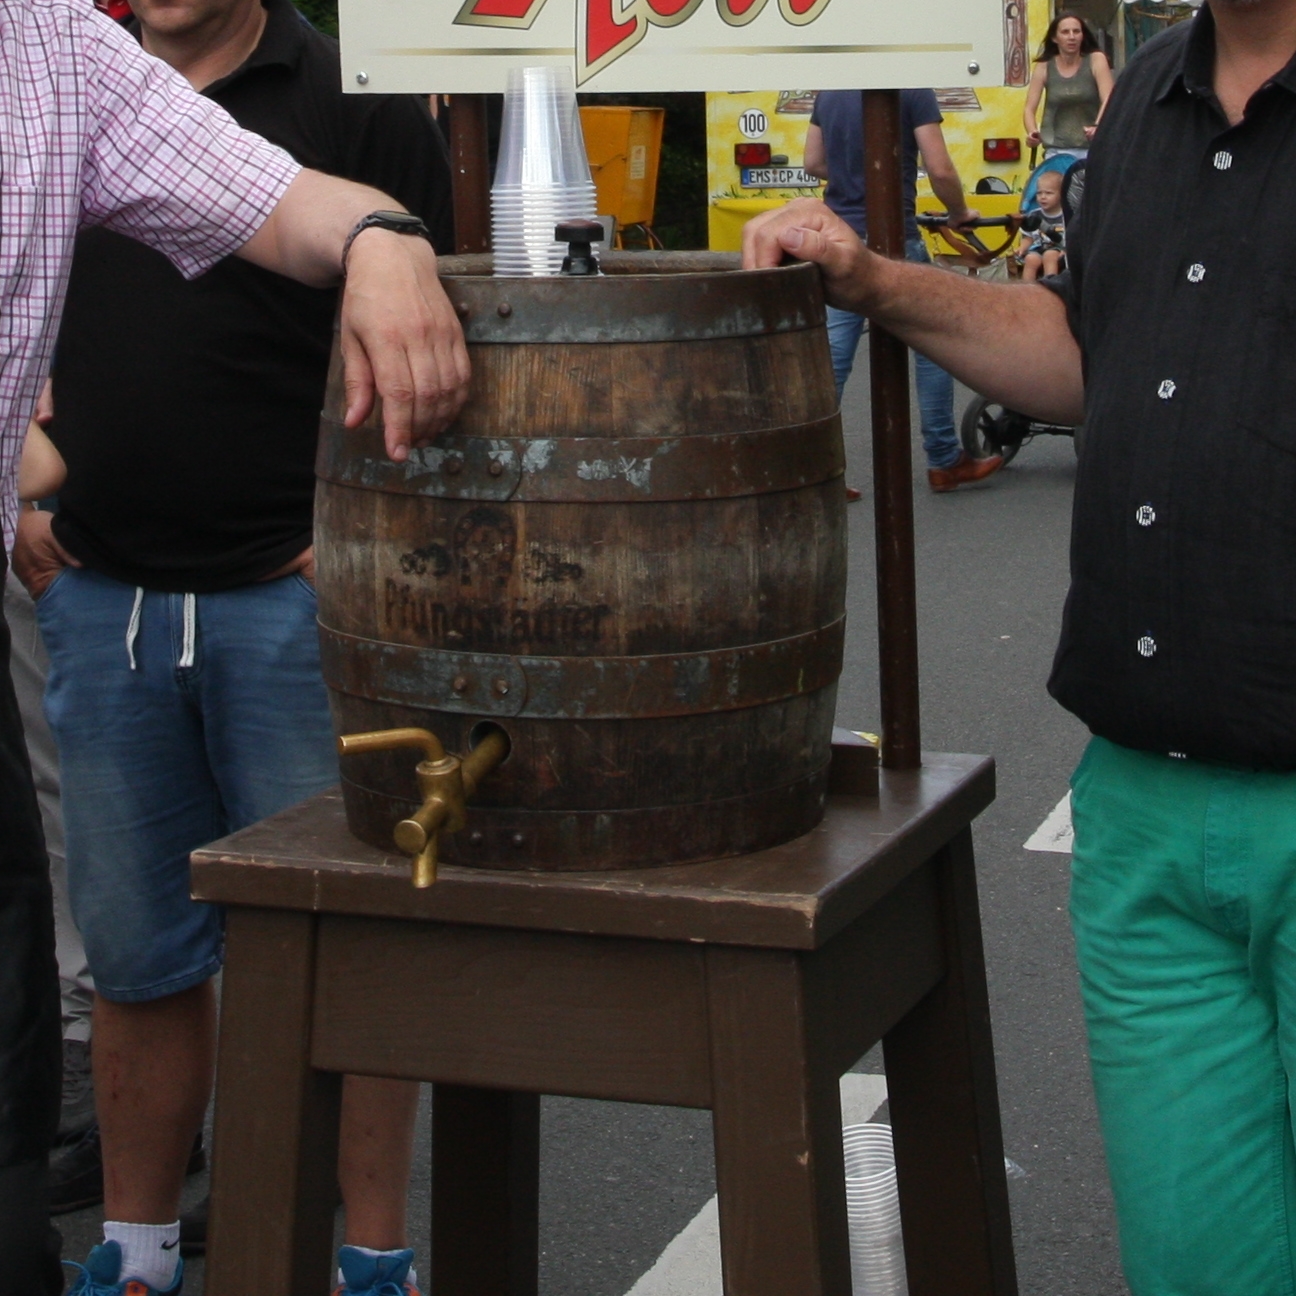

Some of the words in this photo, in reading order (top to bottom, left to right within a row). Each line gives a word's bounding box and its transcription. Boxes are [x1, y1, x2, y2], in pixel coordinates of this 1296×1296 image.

[741, 113, 766, 133] 100
[749, 170, 771, 184] EMS
[779, 170, 794, 183] CP
